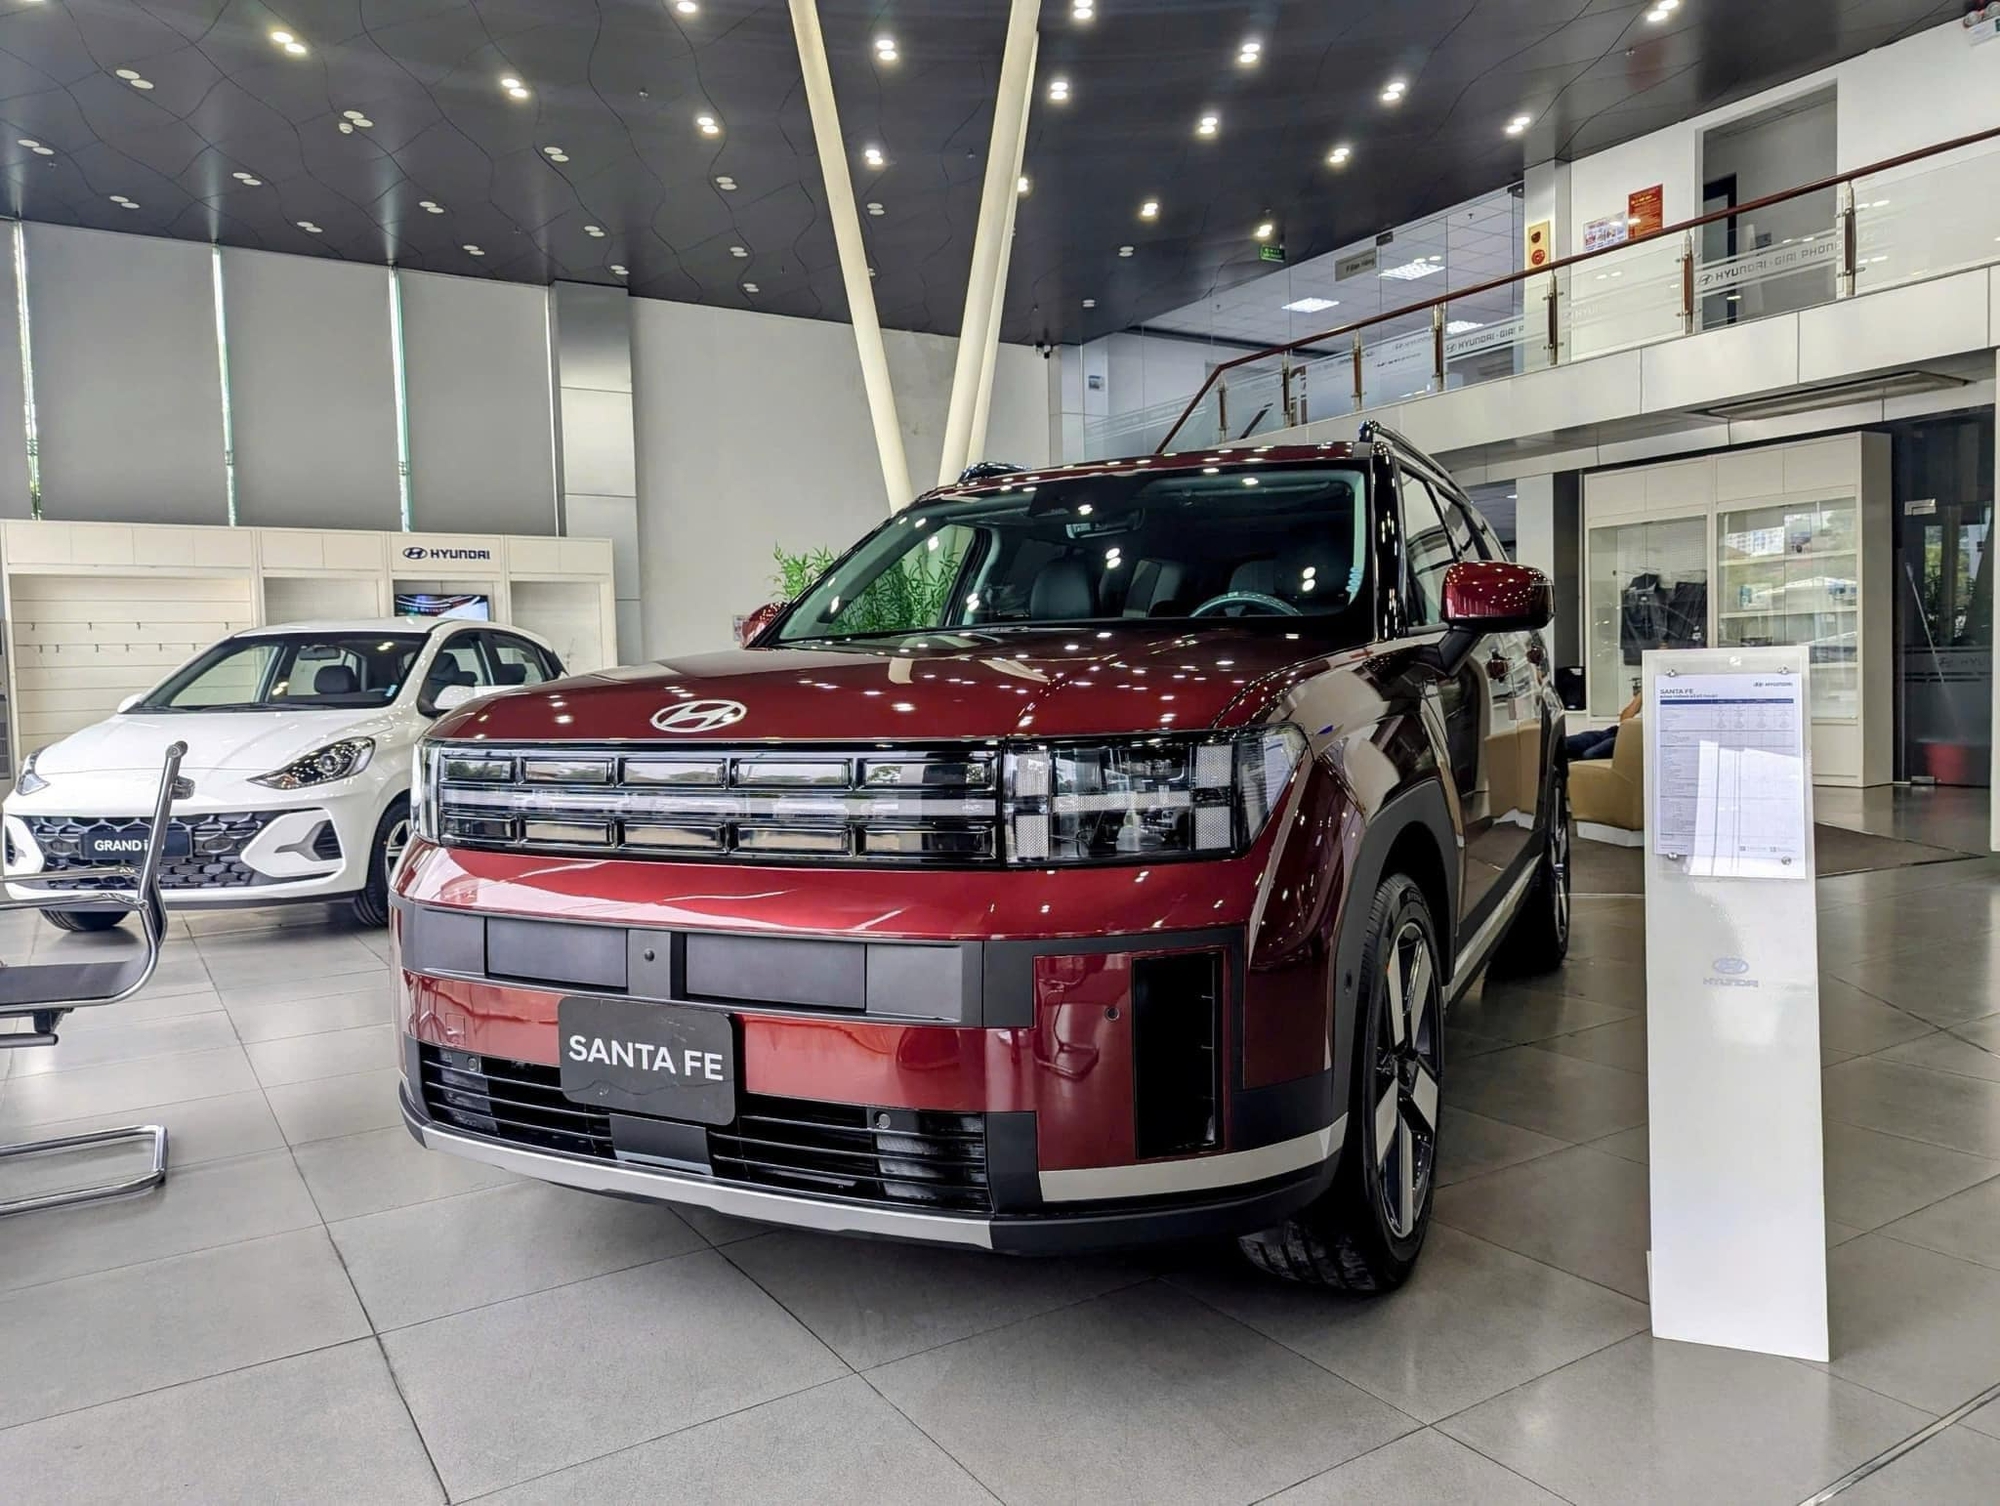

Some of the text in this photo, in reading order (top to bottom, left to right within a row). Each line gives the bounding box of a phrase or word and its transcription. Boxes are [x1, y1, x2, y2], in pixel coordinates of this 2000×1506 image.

[1715, 260, 1767, 281] HYUNDAI
[1458, 333, 1495, 350] HYUNDAI
[430, 549, 490, 559] HYUNDAI
[94, 840, 141, 851] GRAND
[568, 1034, 724, 1081] SANTA FE
